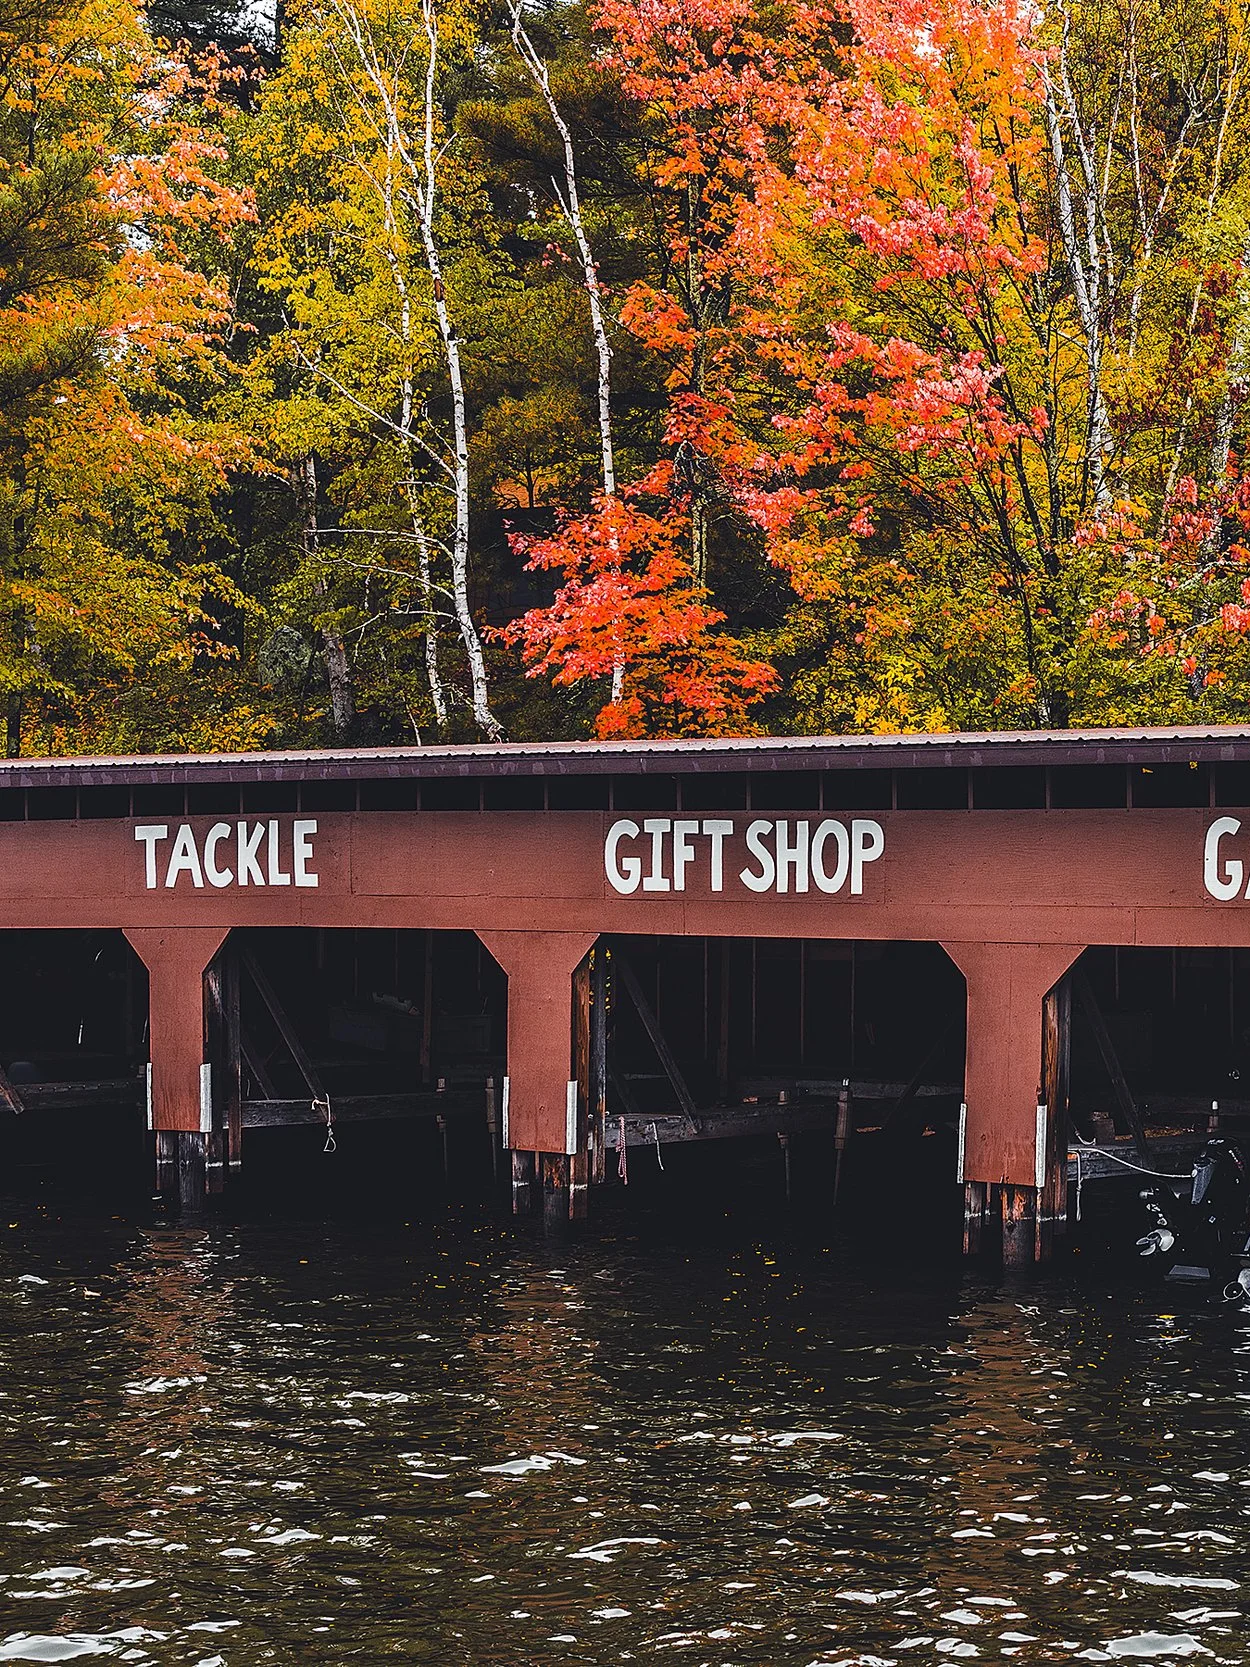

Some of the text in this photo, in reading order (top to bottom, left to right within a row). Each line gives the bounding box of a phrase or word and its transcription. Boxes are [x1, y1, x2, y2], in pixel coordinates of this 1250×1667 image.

[134, 820, 319, 889] TACKLE
[604, 818, 885, 895] GIFT SHOP
